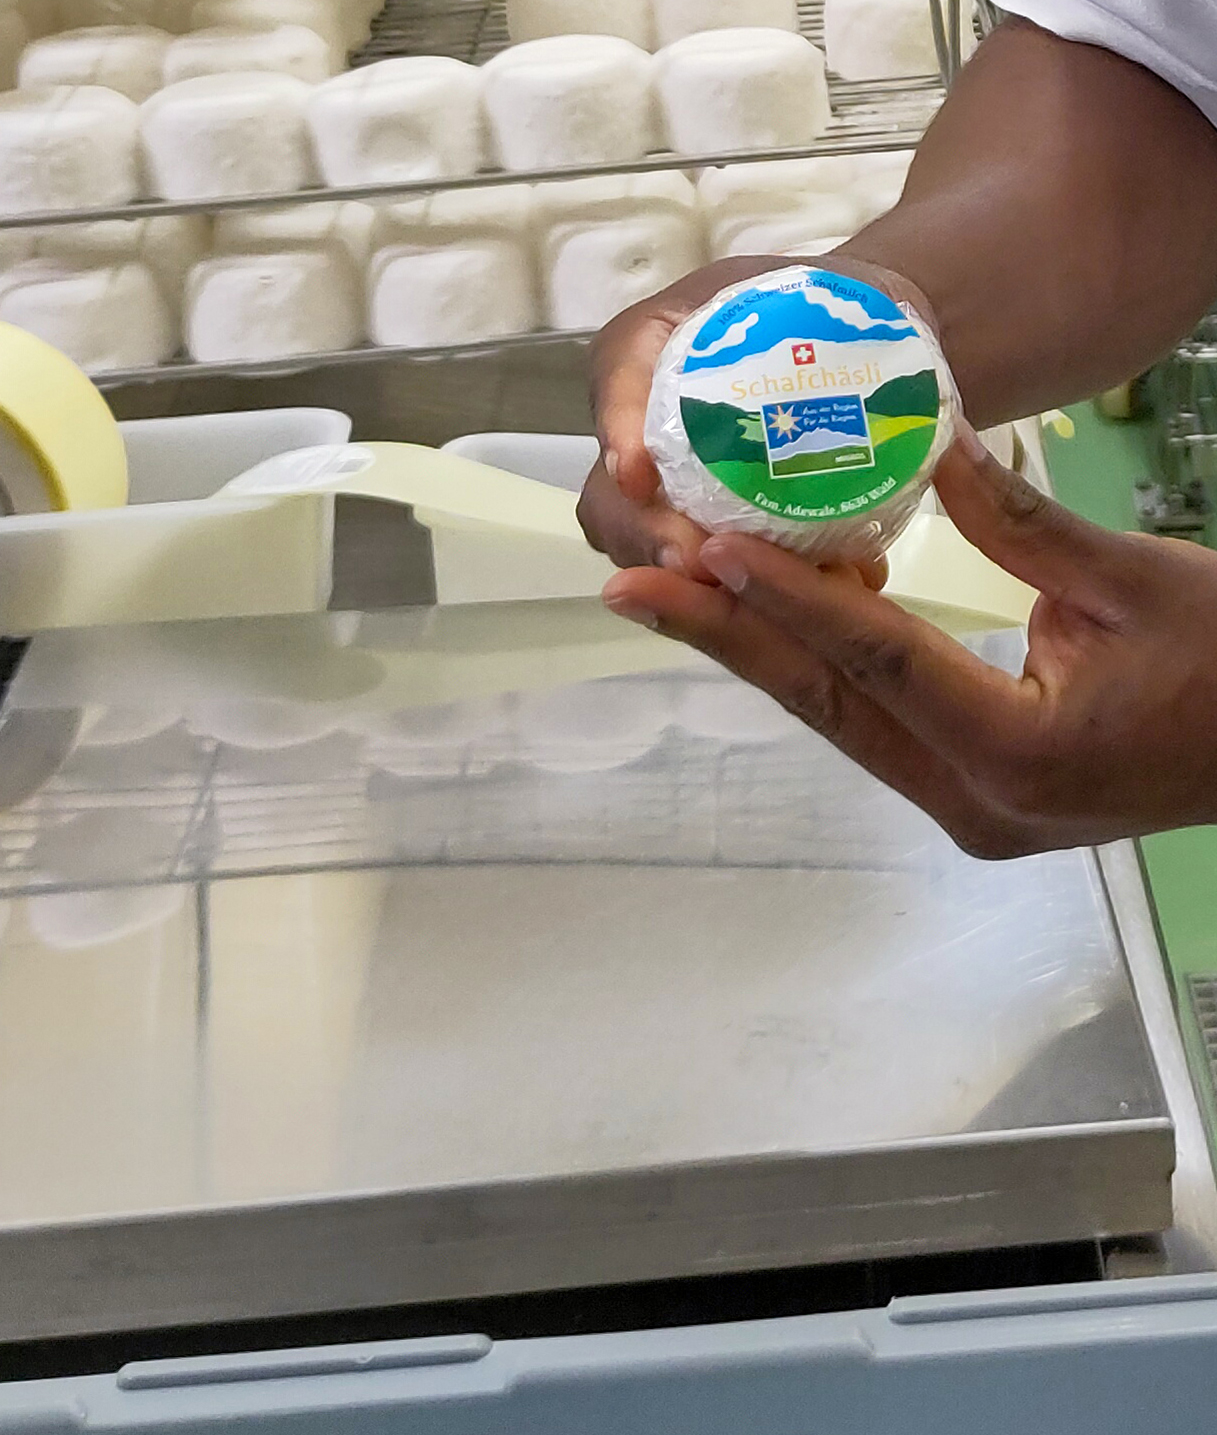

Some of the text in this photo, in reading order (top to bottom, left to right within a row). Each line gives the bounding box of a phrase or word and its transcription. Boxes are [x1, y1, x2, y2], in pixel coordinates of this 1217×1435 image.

[718, 277, 869, 325] 100% Schweizer Schafmilch
[730, 362, 882, 400] Schafchäsli
